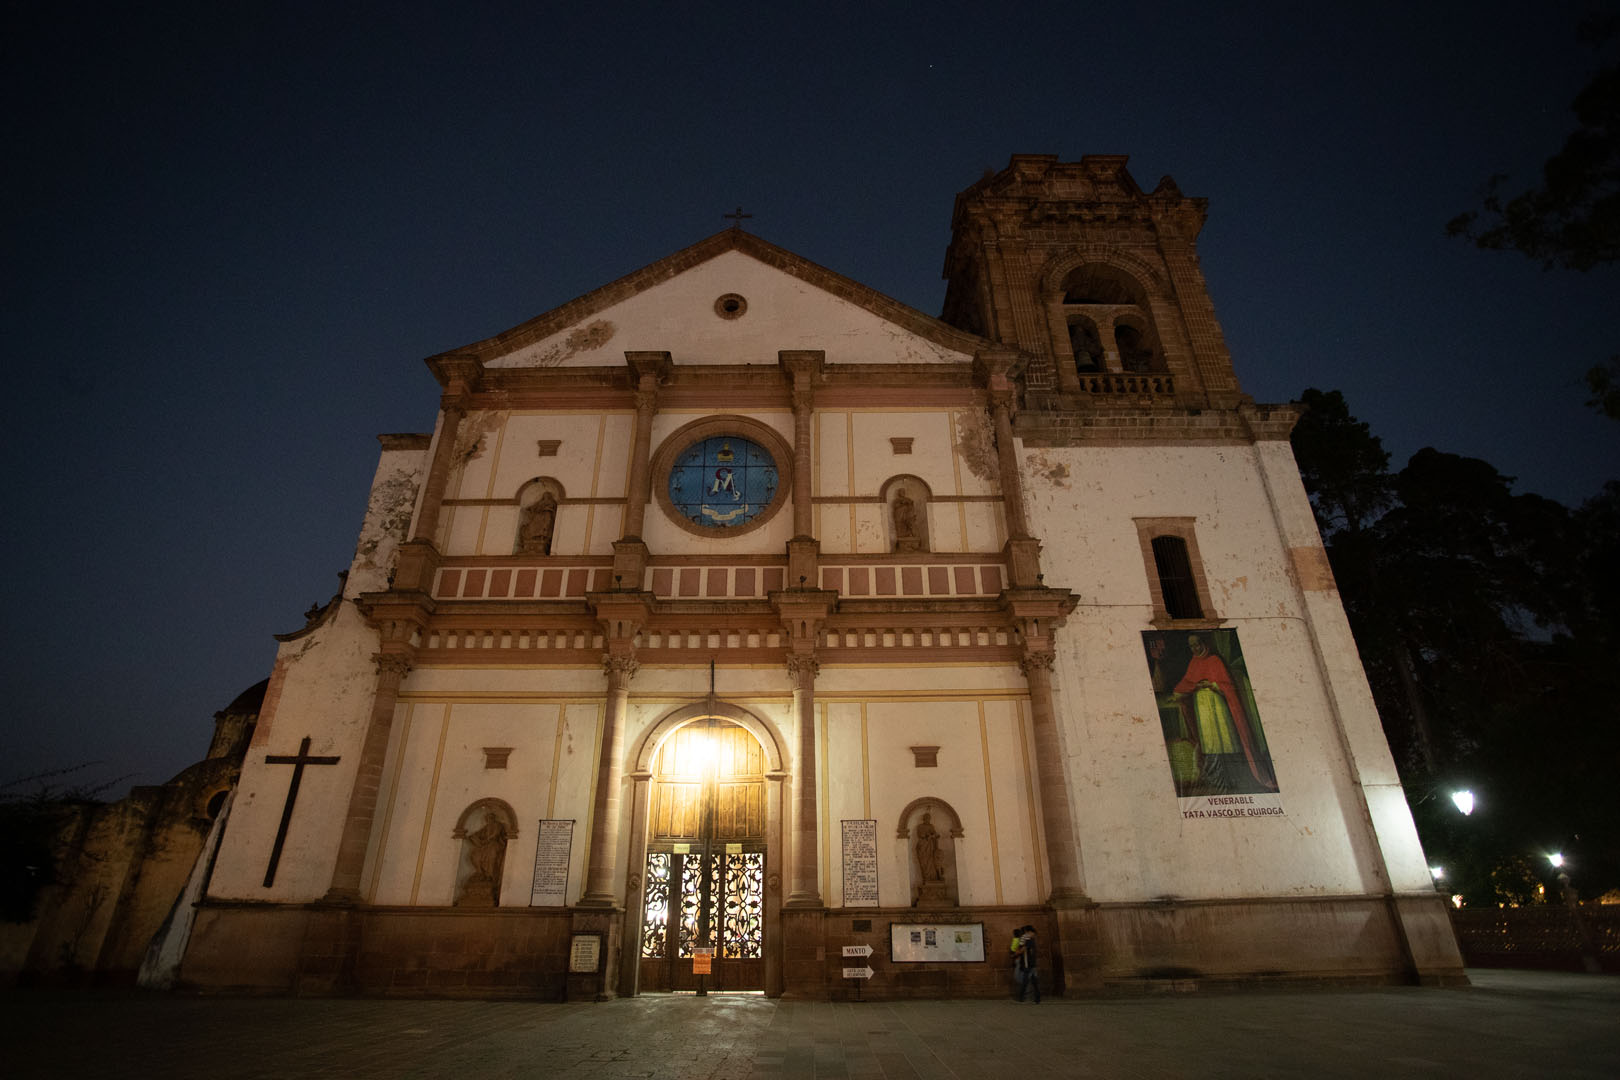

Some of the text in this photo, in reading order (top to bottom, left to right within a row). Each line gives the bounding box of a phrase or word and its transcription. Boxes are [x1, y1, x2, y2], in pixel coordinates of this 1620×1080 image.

[1208, 796, 1254, 806] VENERABLE
[1183, 807, 1284, 818] TATA VASCO DE QUIROGA
